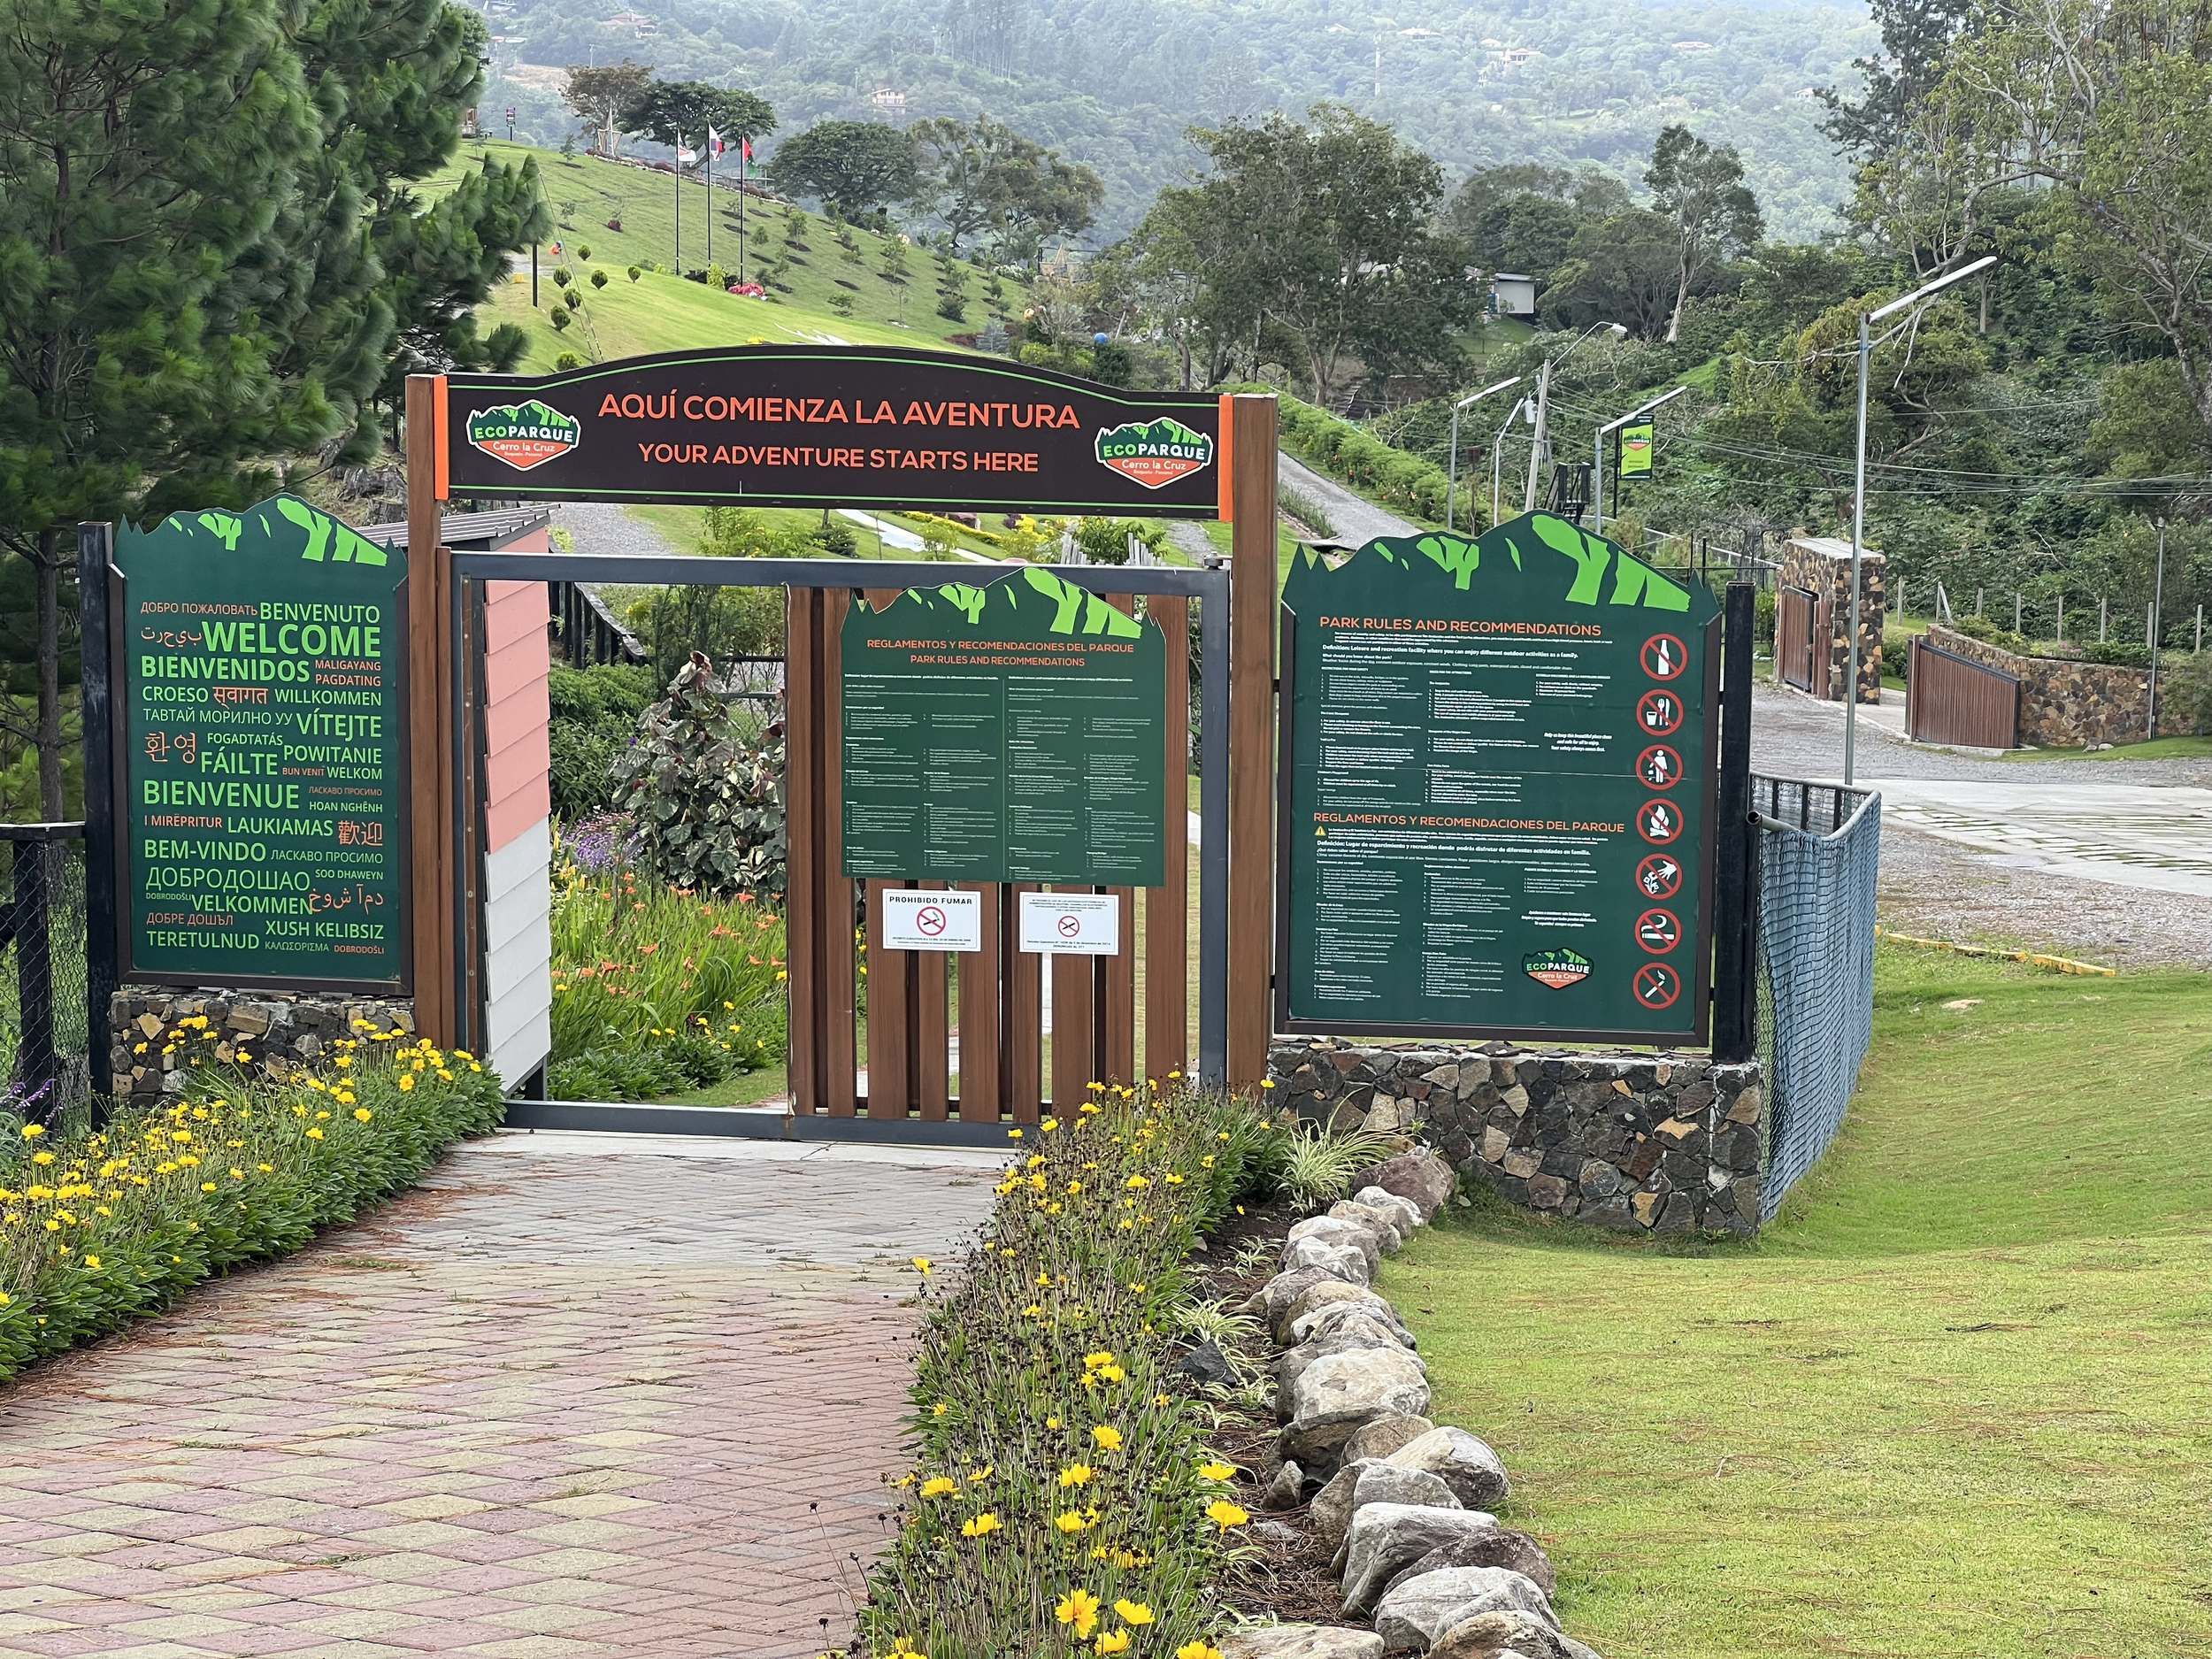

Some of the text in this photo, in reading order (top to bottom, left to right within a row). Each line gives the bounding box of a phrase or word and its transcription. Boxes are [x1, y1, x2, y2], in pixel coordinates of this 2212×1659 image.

[598, 389, 1079, 428] AQUÍ COMIENZA LA AVENTURA
[475, 426, 572, 442] ECOPARQUE
[493, 442, 519, 450] Cerro
[1103, 443, 1205, 459] ECOPARQUE
[639, 443, 1038, 472] YOUR ADVENTURE STARTS HERE
[1122, 459, 1148, 468] Cerro
[1153, 460, 1160, 469] la
[141, 603, 257, 615] ДОБРО ПОЖАЛОВАТЬ
[260, 603, 380, 623] BENVENUTO
[1320, 617, 1601, 635] PARK RULES AND RECOMMENDATIONS
[202, 620, 380, 657] WELCOME
[867, 640, 947, 649] REGLAMENTOS
[958, 641, 1064, 650] RECOMENDACIONES
[142, 656, 310, 681] BIENVENIDOS
[316, 660, 380, 671] MALIGAYANG
[992, 657, 1085, 666] RECOMMENDATIONS
[316, 674, 380, 686] PAGDATING
[143, 687, 208, 702] CROESO
[275, 689, 380, 705] WILLKOMMEN
[143, 707, 292, 725] ТАВТАЙ МОРИЛНО УУ
[296, 709, 381, 741] VÍTEJTE
[208, 732, 282, 745] FOGADTATÁS
[202, 747, 277, 775] FÁILTE
[284, 745, 381, 764] POWITANIE
[327, 766, 381, 780] WELKOM
[144, 780, 299, 809] BIENVENUE
[310, 801, 382, 812] HOAN NGHÊNH
[152, 816, 222, 827] MIRËPRITUR
[228, 817, 333, 836] LAUKIAMAS
[1314, 813, 1406, 825] REGLAMENTOS
[1420, 817, 1543, 828] RECOMENDACIONES
[1547, 821, 1570, 830] DEL
[1573, 822, 1624, 832] PARQUE
[338, 820, 382, 846] 歡迎
[145, 840, 265, 861] BEM-VINDO
[271, 850, 382, 864] ЛАСКАВО ПРОСИМО
[146, 867, 310, 893] ДОБРОДОШАО
[338, 871, 383, 879] DHAWEYN
[192, 895, 312, 914] VELKOMMEN
[147, 913, 233, 926] ДОБРЕ ДОШЪЛ
[265, 920, 383, 939] XUSH KELIBSIZ
[147, 931, 259, 949] TERETULNUD
[265, 941, 329, 951] ΚΑΛΩΣΟΡΙΣΜΑ
[334, 945, 384, 954] DOBRODOŠLI
[1526, 963, 1590, 973] ECOPARQUE
